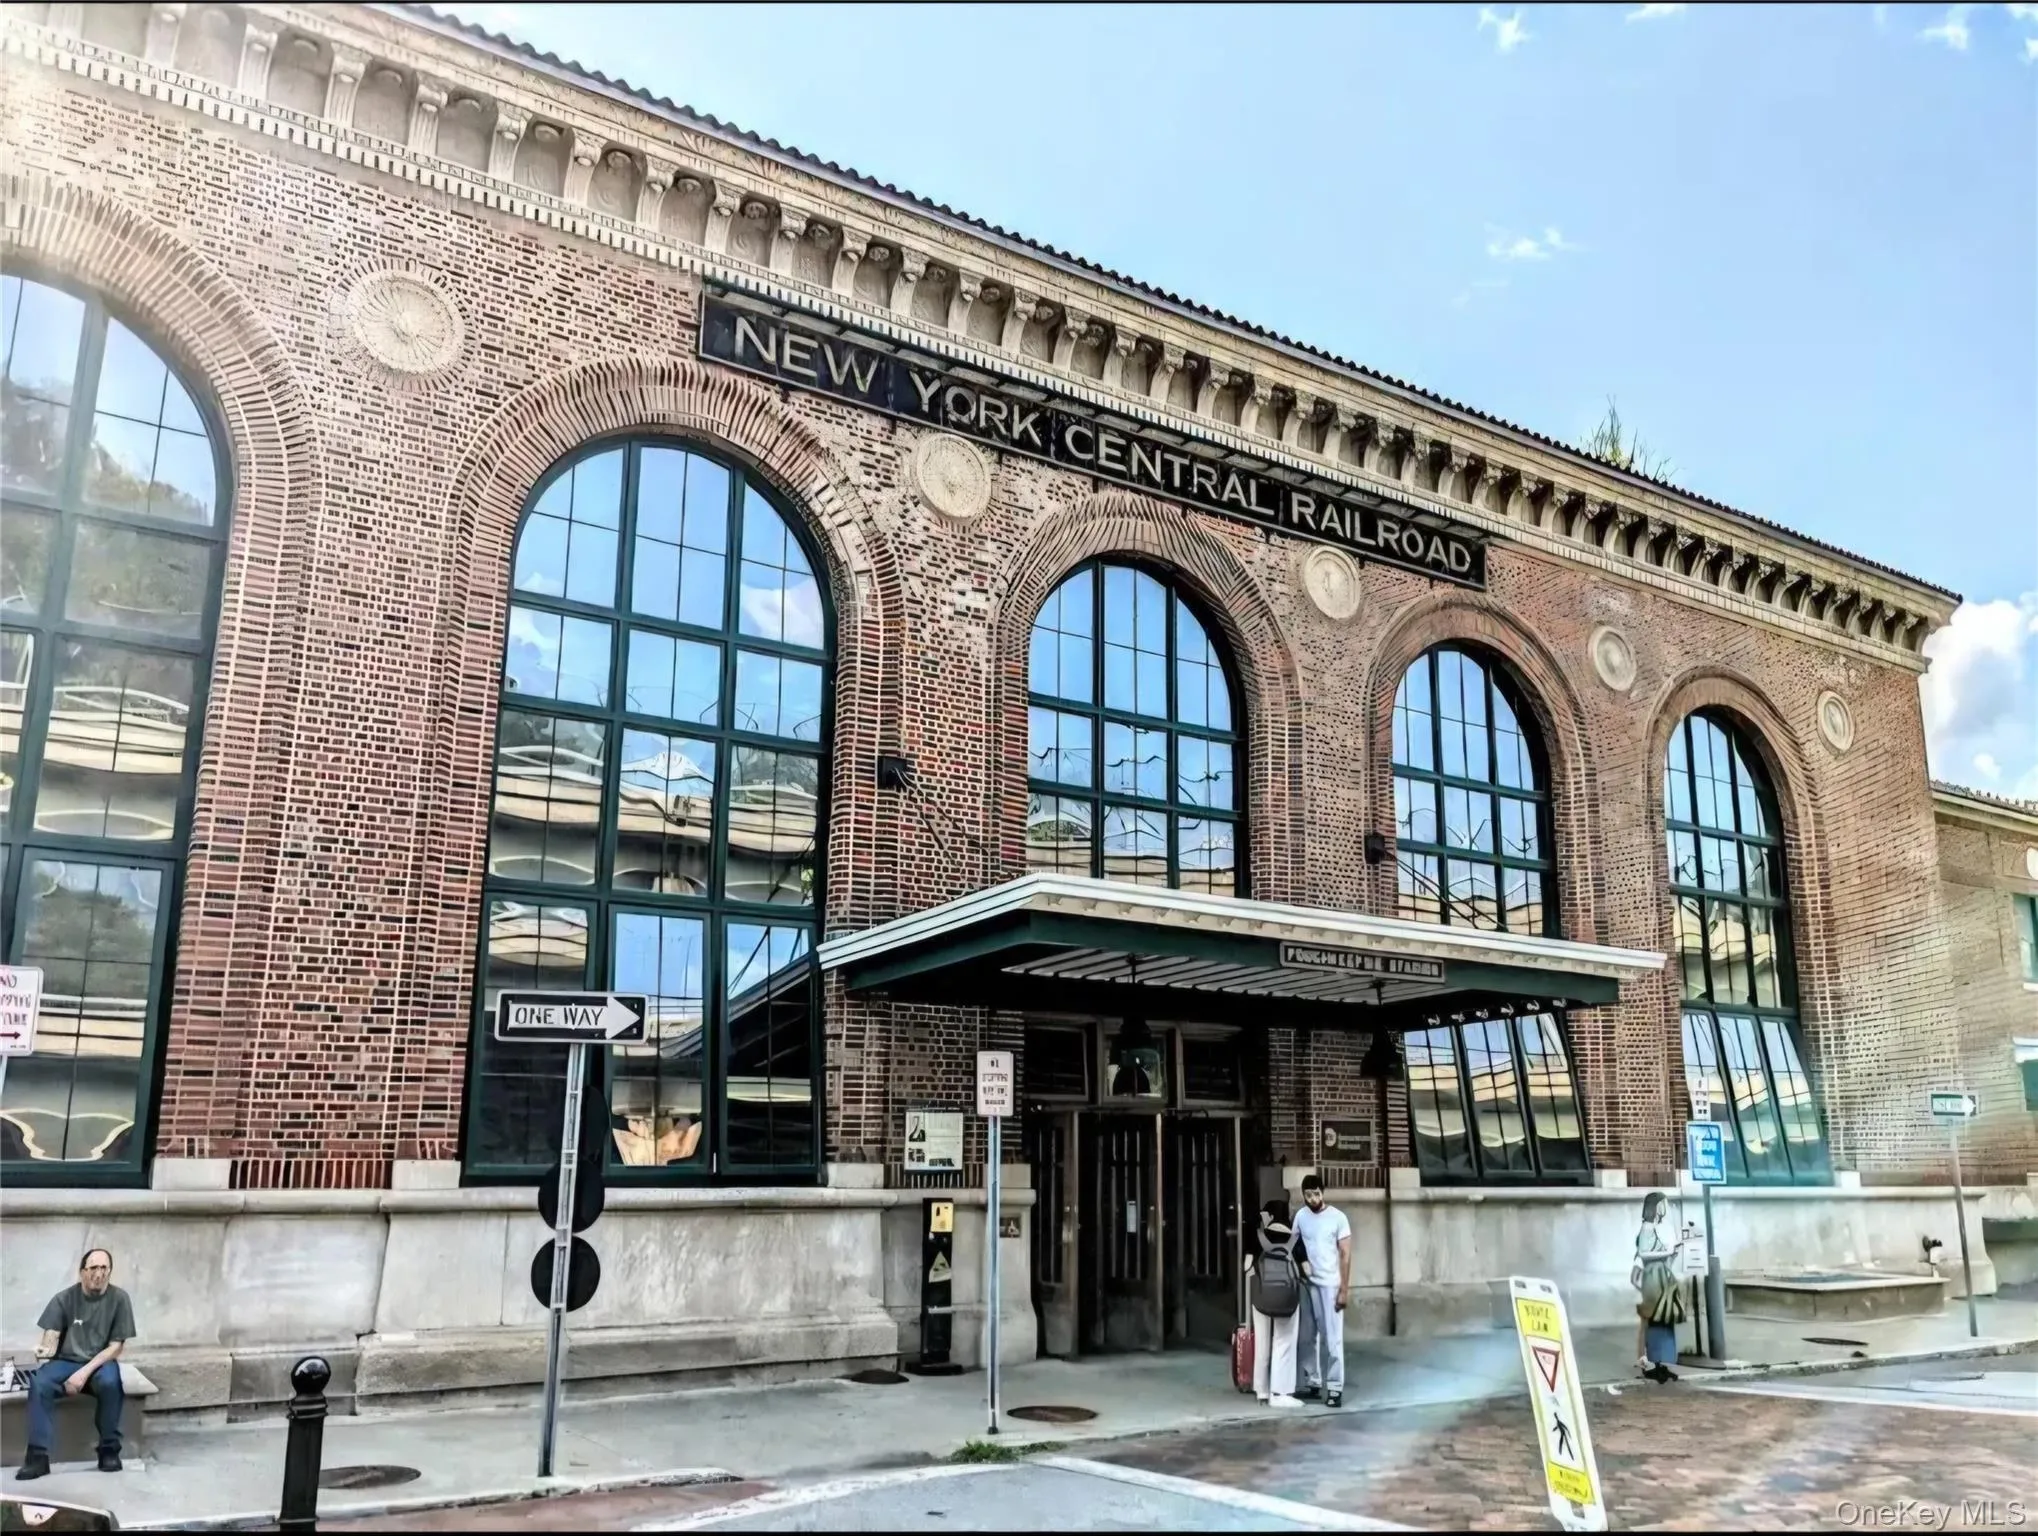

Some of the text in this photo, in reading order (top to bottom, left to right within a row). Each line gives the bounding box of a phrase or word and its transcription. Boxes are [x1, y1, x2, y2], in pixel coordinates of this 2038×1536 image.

[733, 314, 1473, 574] NEW YORK CENTRAL RAILROAD
[515, 1007, 605, 1026] ONE WAY
